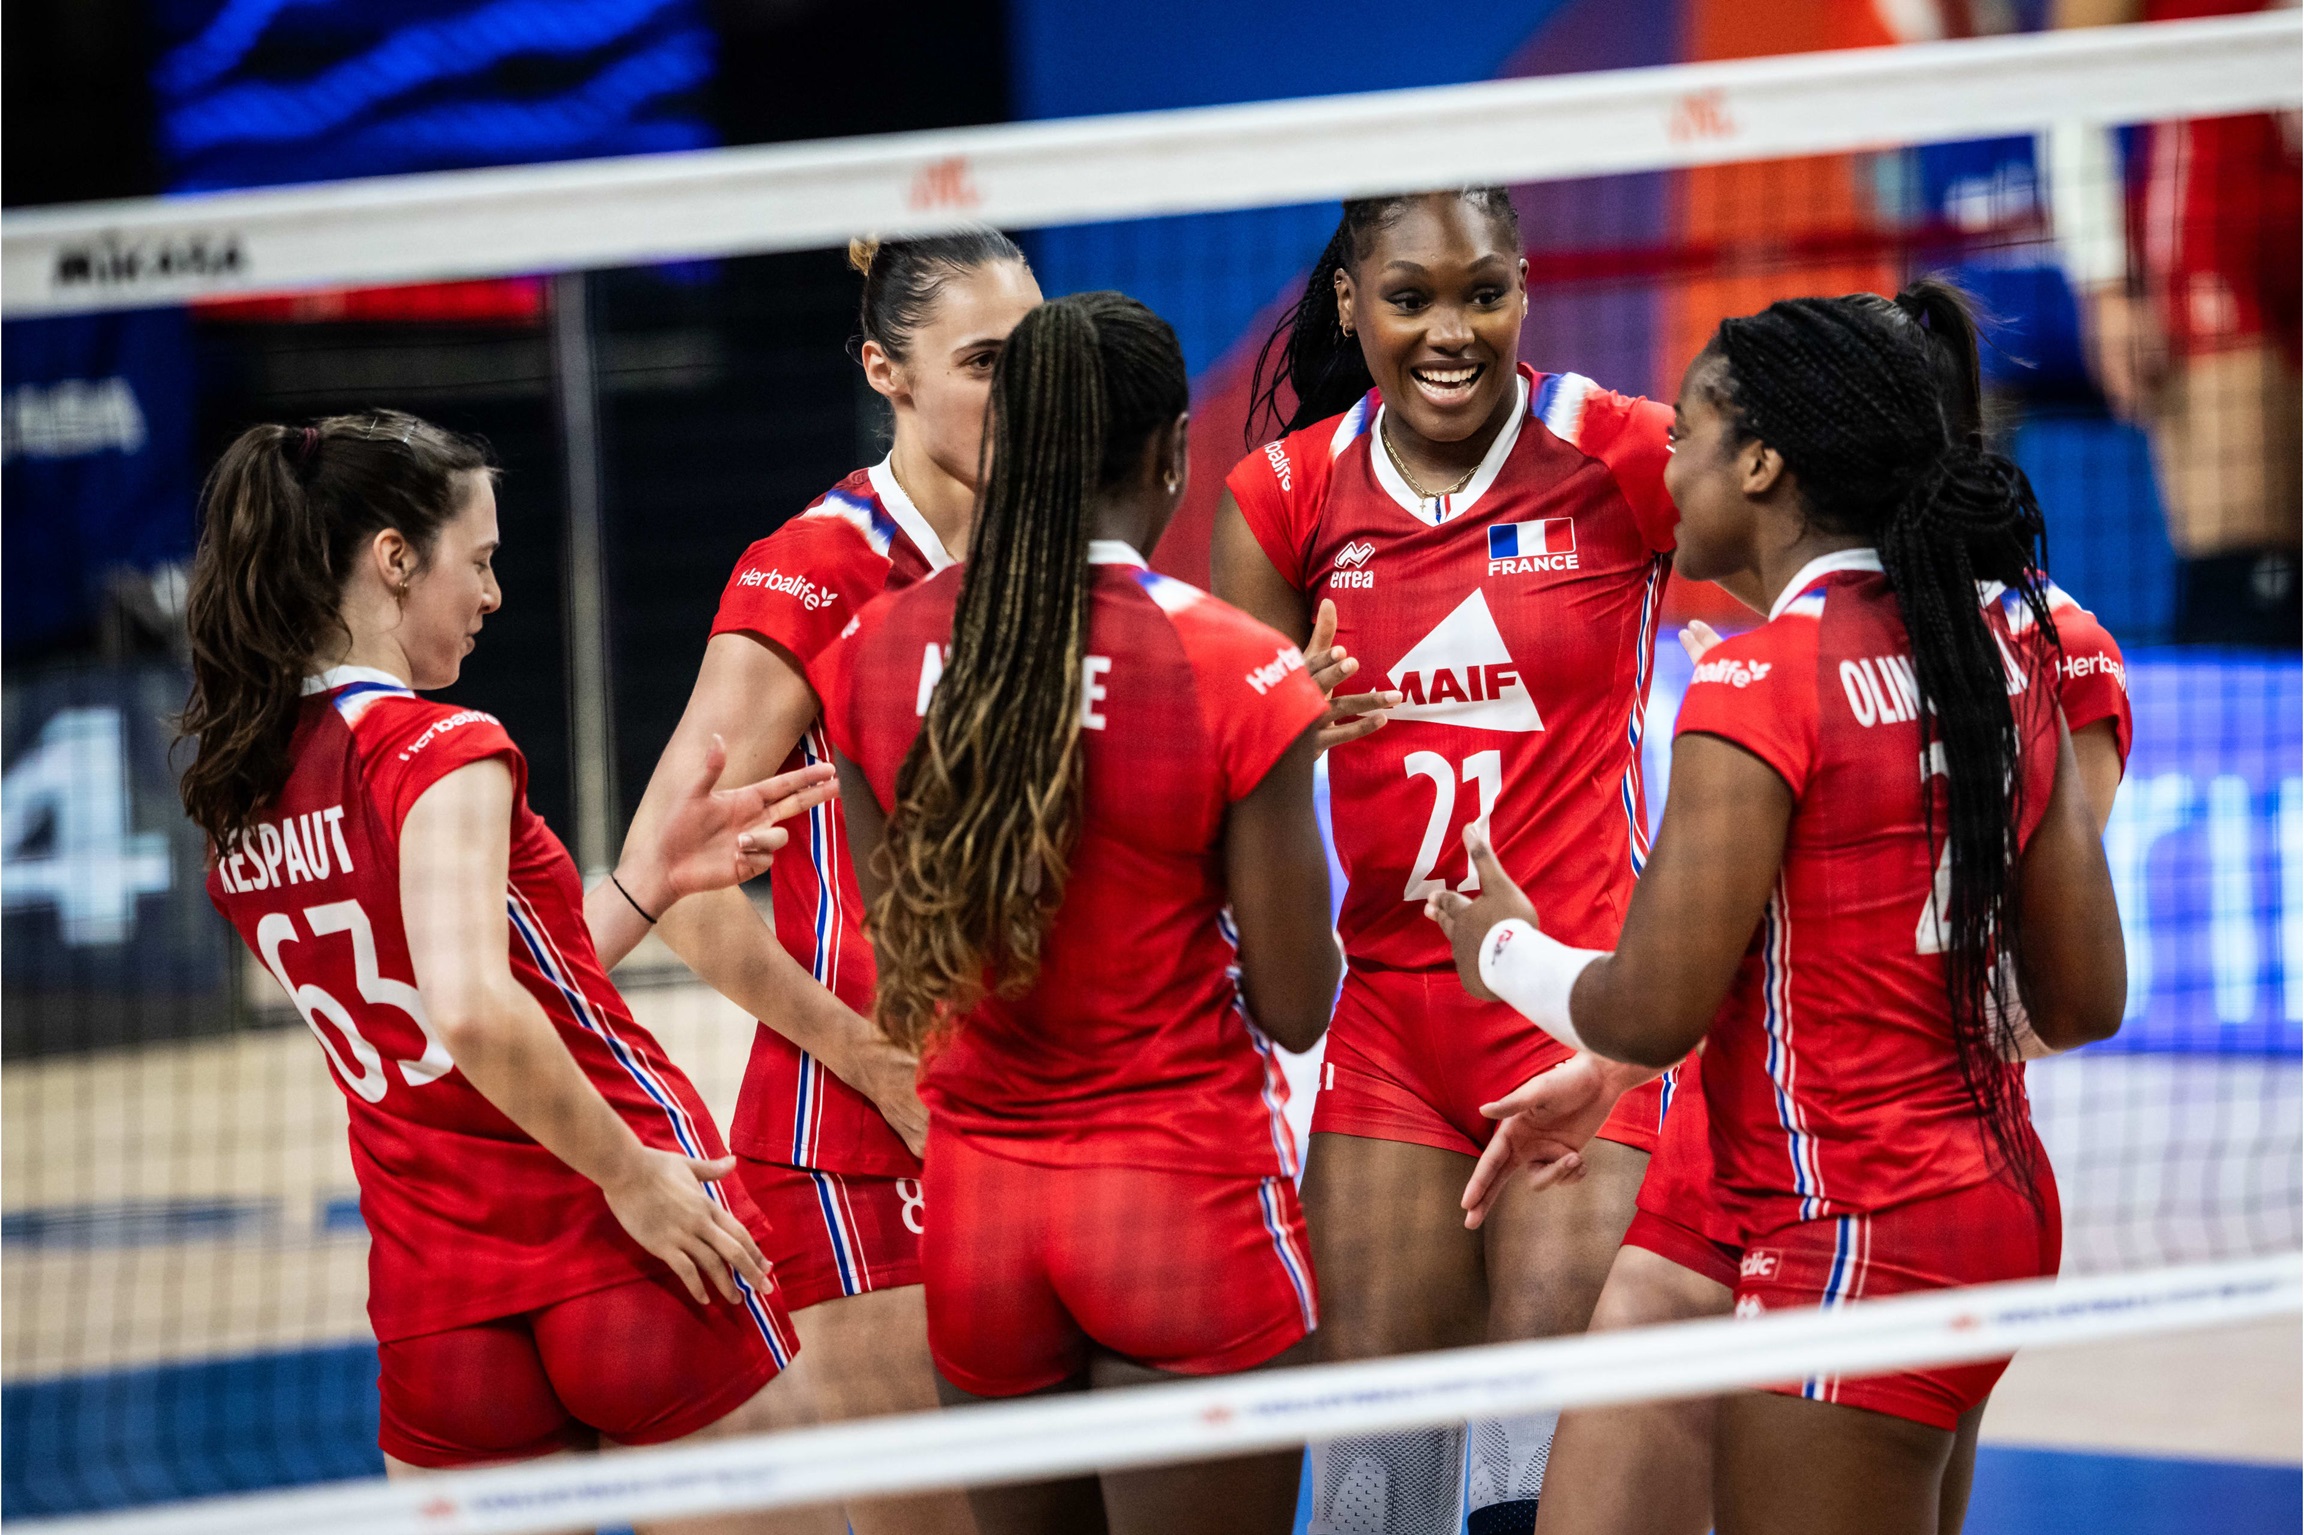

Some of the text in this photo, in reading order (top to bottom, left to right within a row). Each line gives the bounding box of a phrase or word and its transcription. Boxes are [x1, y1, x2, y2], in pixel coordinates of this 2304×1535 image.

[1330, 570, 1374, 589] errea
[1488, 554, 1580, 577] FRANCE
[737, 567, 820, 611] Herbalife
[1388, 663, 1517, 709] MAIF
[1403, 750, 1502, 901] 21
[257, 899, 454, 1103] 63
